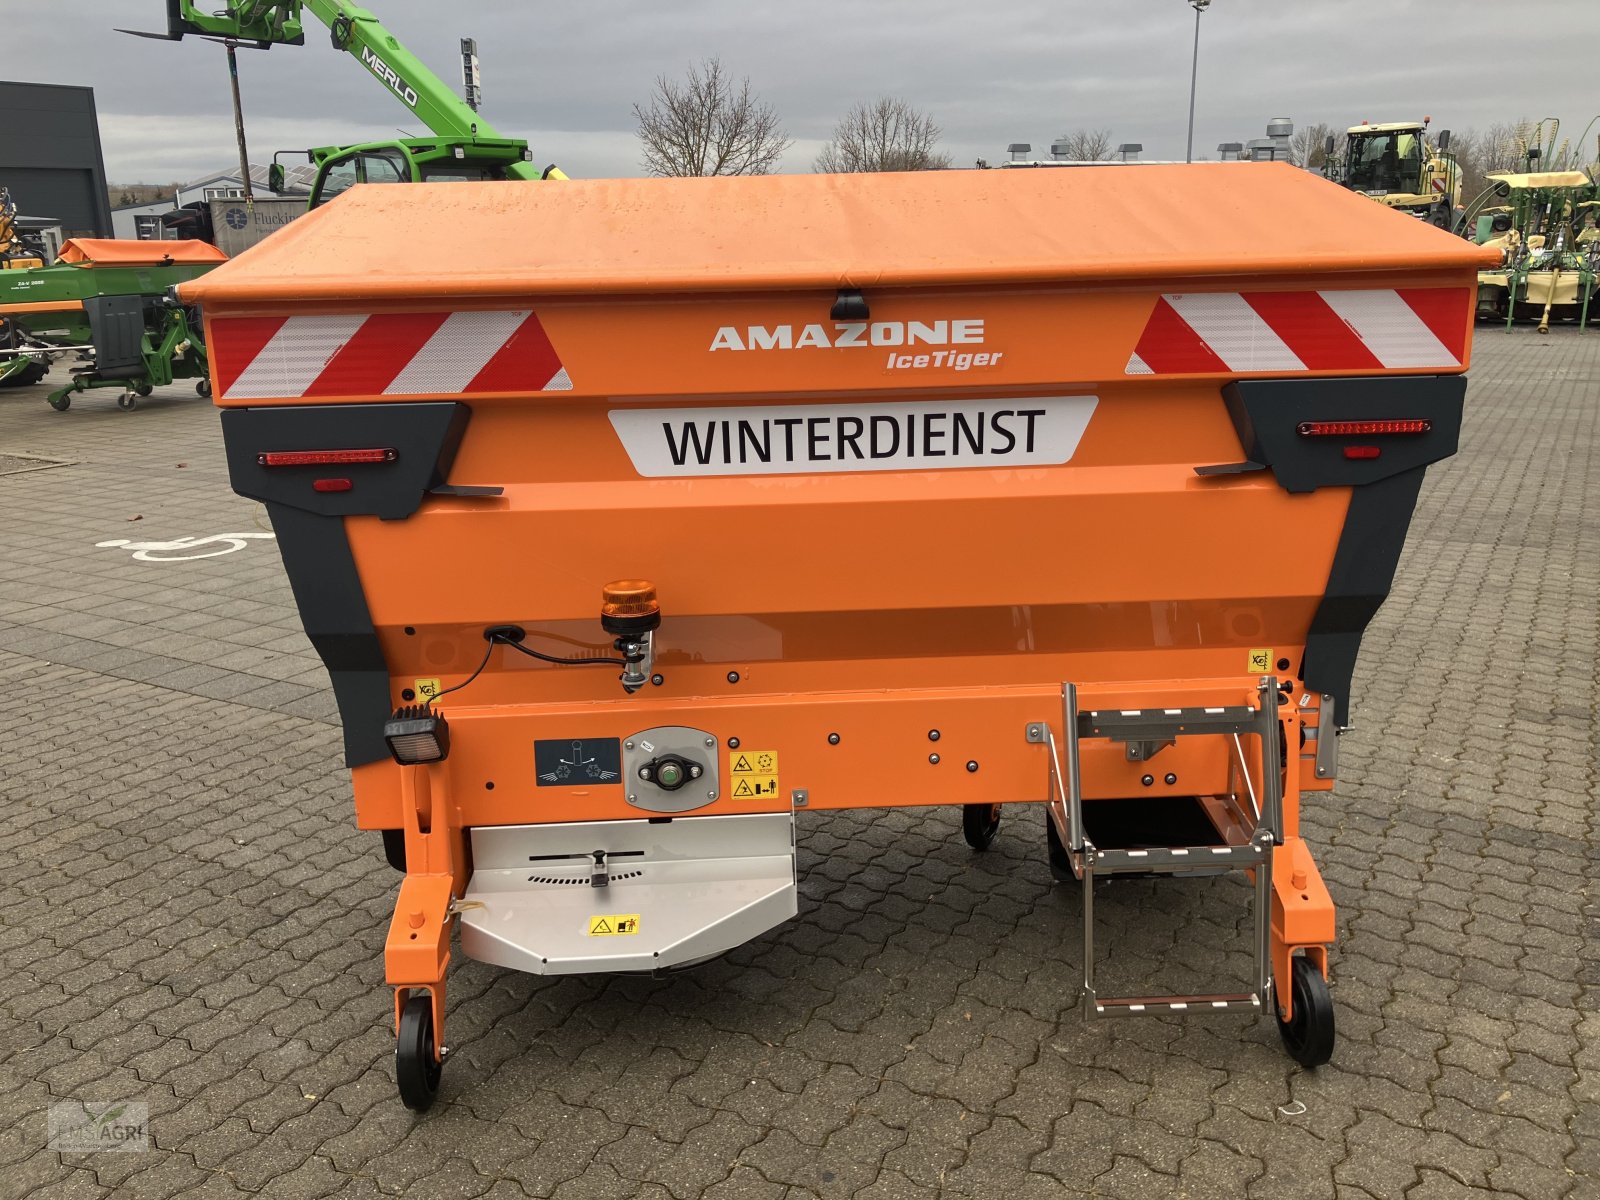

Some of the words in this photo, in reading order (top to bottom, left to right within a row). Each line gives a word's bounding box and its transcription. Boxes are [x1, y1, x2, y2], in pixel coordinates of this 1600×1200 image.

[361, 45, 418, 107] MERLO
[254, 211, 301, 225] Fluckin
[709, 318, 985, 352] AMAZONE
[886, 350, 1003, 371] IceTiger
[662, 409, 1046, 466] WINTERDIENST
